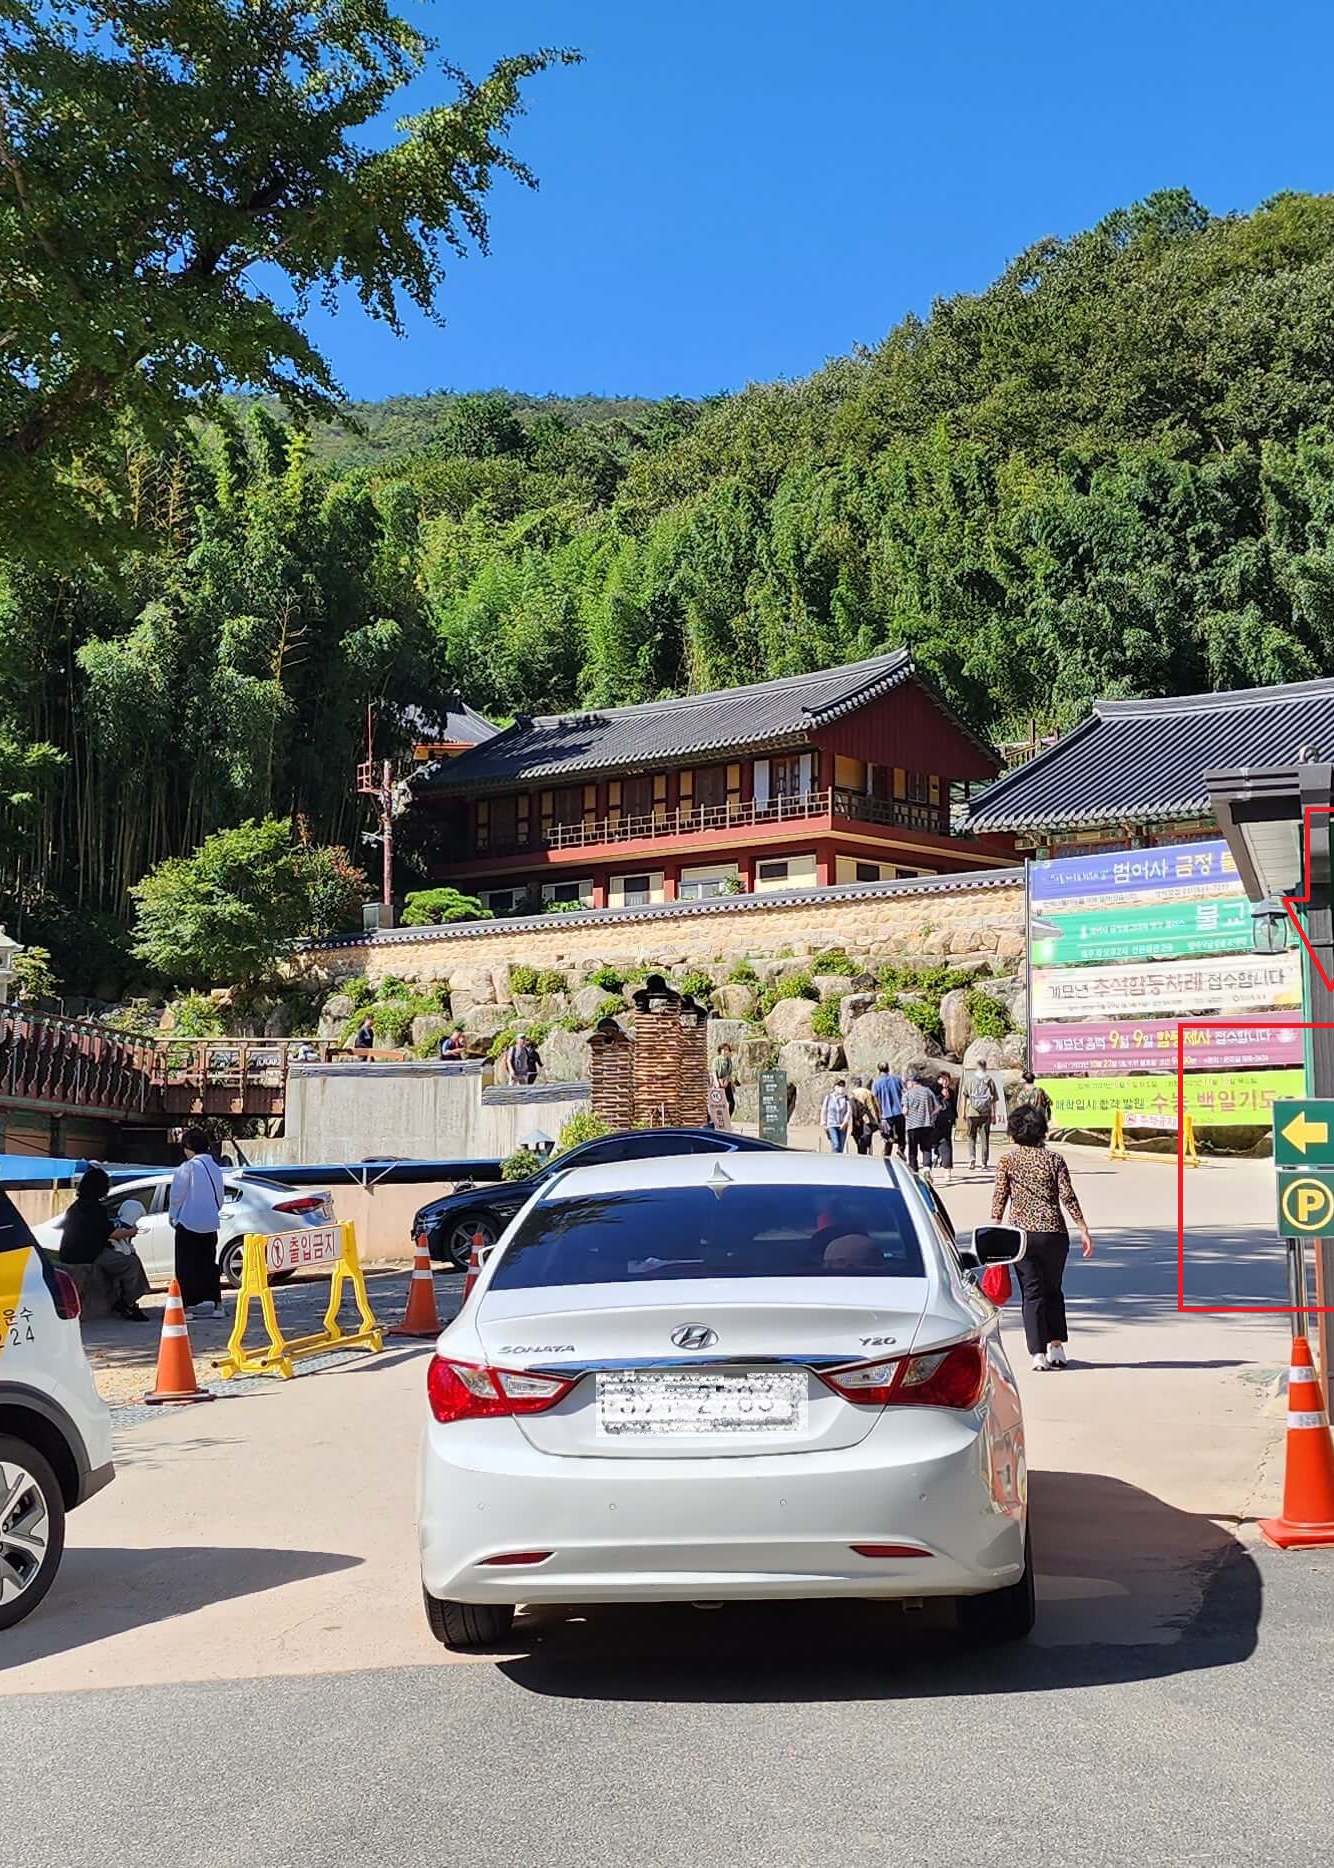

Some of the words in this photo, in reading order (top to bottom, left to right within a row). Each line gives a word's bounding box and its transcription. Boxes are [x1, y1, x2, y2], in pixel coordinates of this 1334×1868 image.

[1114, 858, 1169, 884] 범어사
[1176, 852, 1213, 878] 금정
[1208, 968, 1286, 991] 접수합니다
[1132, 1029, 1153, 1048] 9일
[1196, 1089, 1278, 1113] 백일기도
[1297, 1188, 1325, 1222] P
[289, 1231, 335, 1264] 출입금지
[497, 1345, 576, 1354] SONATA
[858, 1336, 897, 1346] Y20
